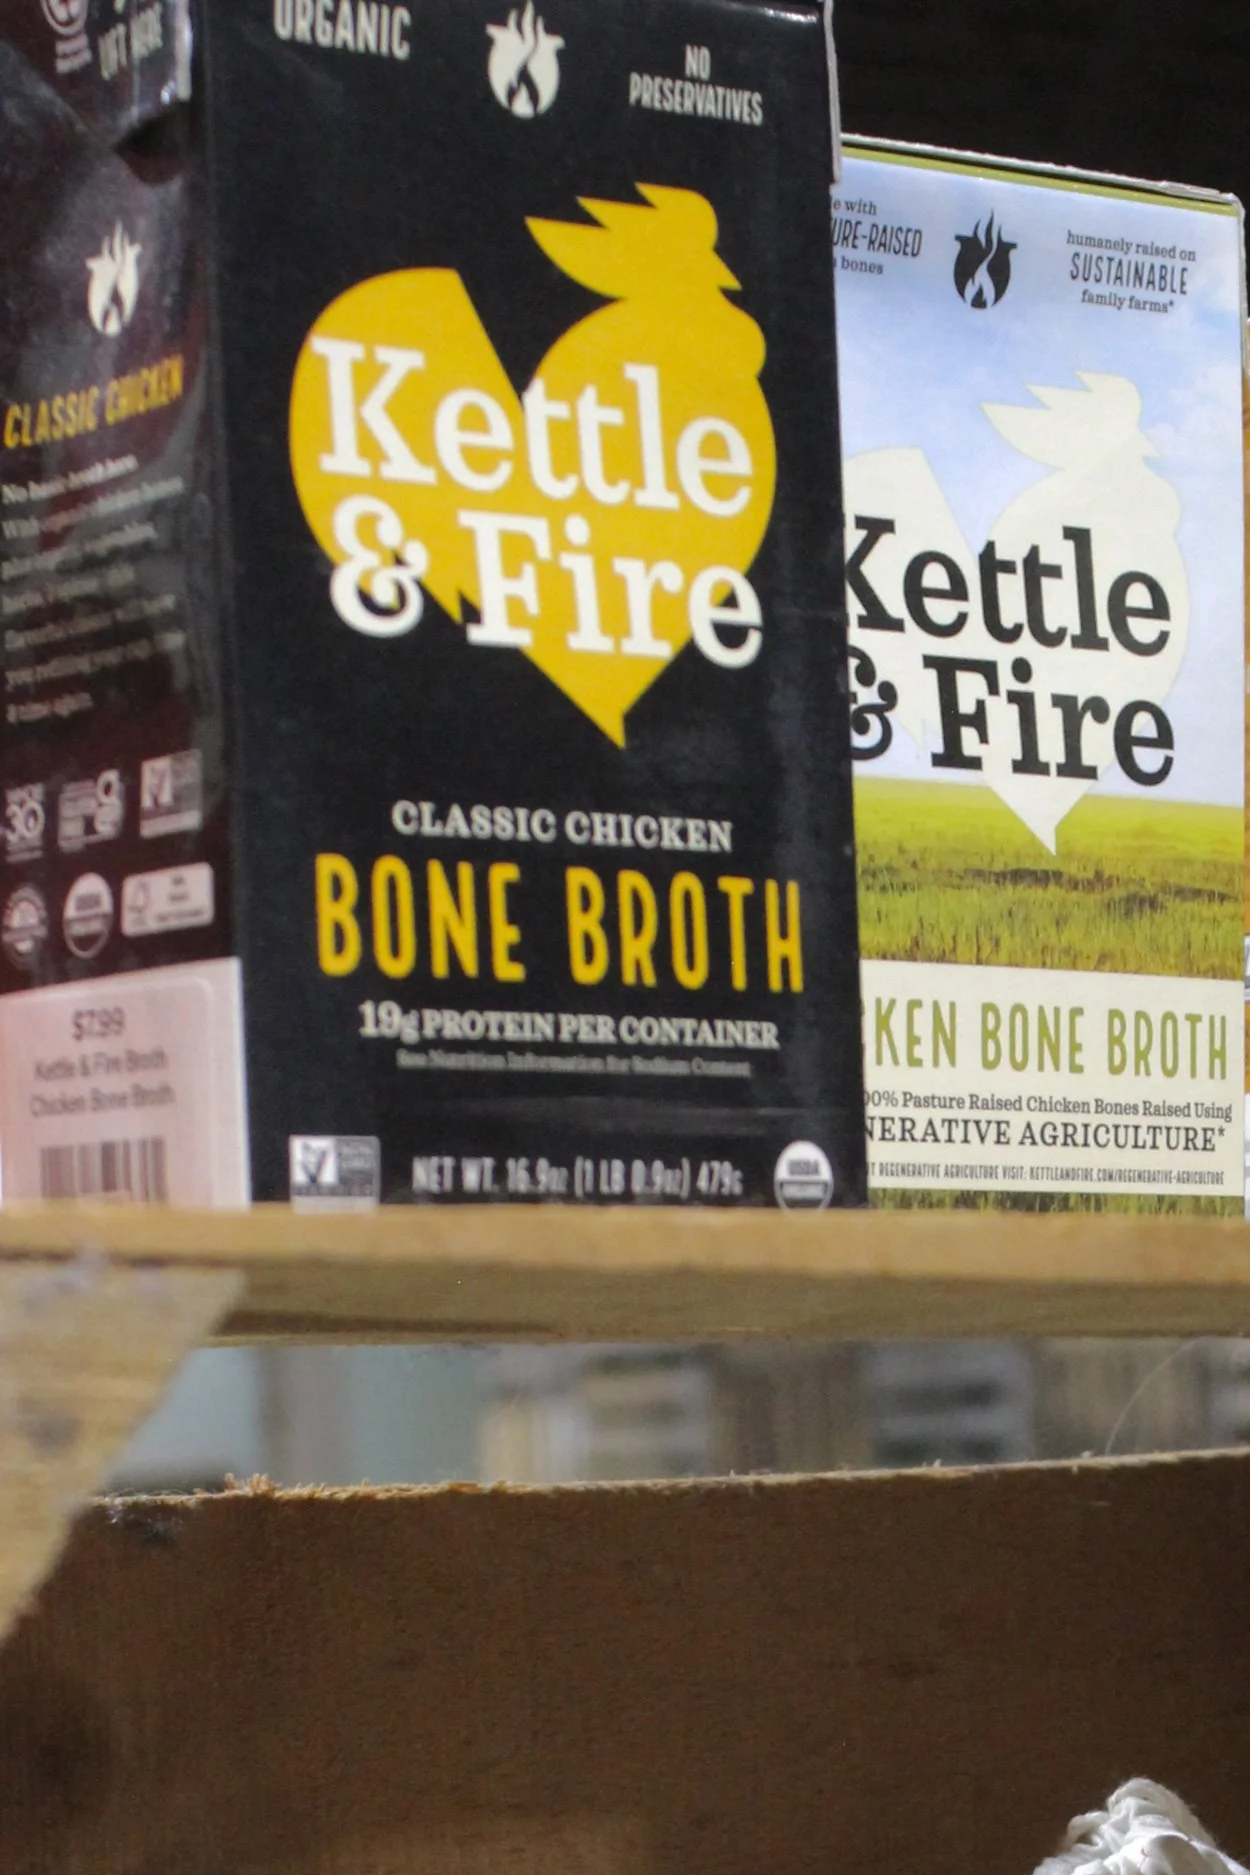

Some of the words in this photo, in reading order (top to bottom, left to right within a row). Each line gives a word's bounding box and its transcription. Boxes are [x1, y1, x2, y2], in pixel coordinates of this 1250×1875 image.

[274, 0, 411, 60] ORGANIC
[685, 44, 711, 79] NO
[629, 72, 764, 127] PRESERVATIVES
[844, 199, 877, 217] with
[841, 256, 884, 275] bones
[1066, 229, 1133, 259] humanely
[1134, 241, 1178, 261] raised
[1179, 248, 1197, 263] on
[1069, 252, 1189, 295] SUSTAINABLE
[1081, 287, 1126, 312] family
[4, 384, 98, 449] CLASSIC
[311, 334, 754, 518] Kettle
[330, 493, 428, 639] &
[458, 507, 765, 670] Fire
[845, 514, 1172, 657] Kettle
[922, 654, 1175, 787] Fire
[391, 800, 558, 843] CLASSIC
[564, 813, 734, 853] CHICKEN
[315, 852, 527, 983] BONE
[564, 865, 805, 993] BROTH
[358, 999, 420, 1044] 19g
[420, 1008, 558, 1042] PROTEIN
[558, 1012, 616, 1045] PER
[618, 1015, 781, 1050] CONTAINER
[980, 1002, 1086, 1074] BONE
[1106, 1008, 1228, 1081] BROTH
[902, 1091, 966, 1110] Pasture
[969, 1093, 1022, 1112] Raised
[1026, 1096, 1091, 1115] Chicken
[1094, 1099, 1139, 1117] Bones
[1141, 1099, 1191, 1119] Raised
[1194, 1102, 1233, 1124] Using
[411, 1156, 453, 1195] NET
[878, 1162, 941, 1179] REGENERATIVE
[943, 1163, 999, 1180] AGRICULTURE
